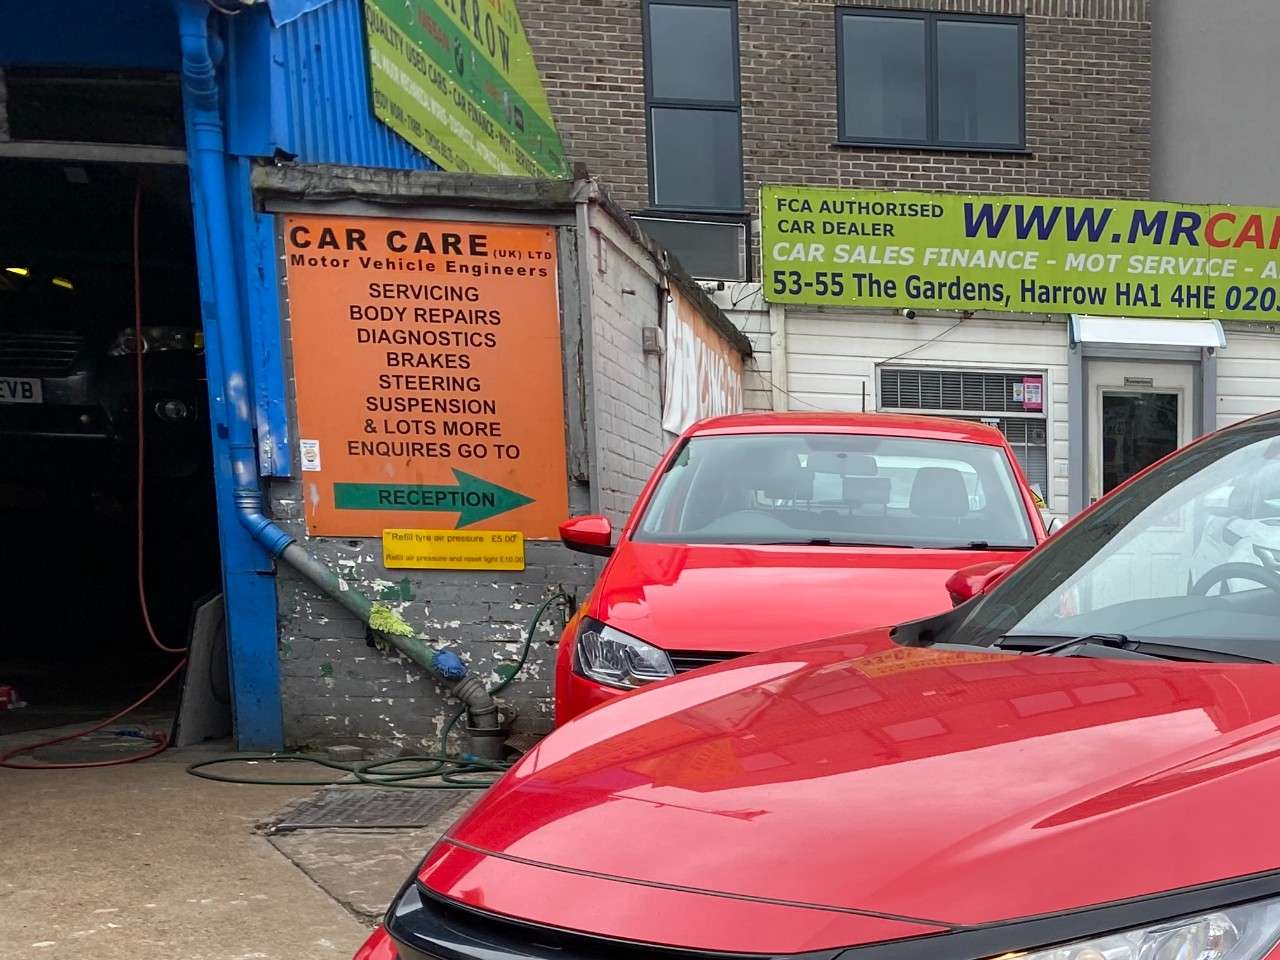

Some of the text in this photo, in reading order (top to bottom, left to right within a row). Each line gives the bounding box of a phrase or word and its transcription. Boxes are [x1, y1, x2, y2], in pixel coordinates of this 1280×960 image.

[777, 199, 944, 218] FCA AUTHORISED
[777, 219, 895, 237] CAR DEALER
[290, 226, 552, 260] CAR CARE (UK) LTD
[290, 255, 548, 278] Motor Vehicle Engineers
[772, 242, 825, 262] CAR
[833, 244, 914, 266] SALES
[922, 248, 1039, 270] FINANCE
[1064, 253, 1123, 274] MOT
[1127, 257, 1237, 278] SERVICE
[369, 283, 479, 302] SERVICING
[773, 270, 844, 297] 53-55
[852, 273, 897, 299] The
[905, 275, 1011, 307] Gardens,
[1020, 279, 1107, 306] Harrow
[1116, 282, 1161, 308] HA1
[1171, 285, 1216, 309] 4HE
[350, 305, 501, 325] BODY REPAIRS
[357, 328, 497, 348] DIAGNOSTICS
[387, 352, 471, 369] BRAKES
[379, 374, 481, 392] STEERING
[366, 396, 496, 415] SUSPENSION
[364, 418, 501, 437] & LOTS MORE
[347, 440, 520, 460] ENQUIRES GO TO
[379, 489, 495, 508] RECEPTION
[447, 535, 484, 543] pressure
